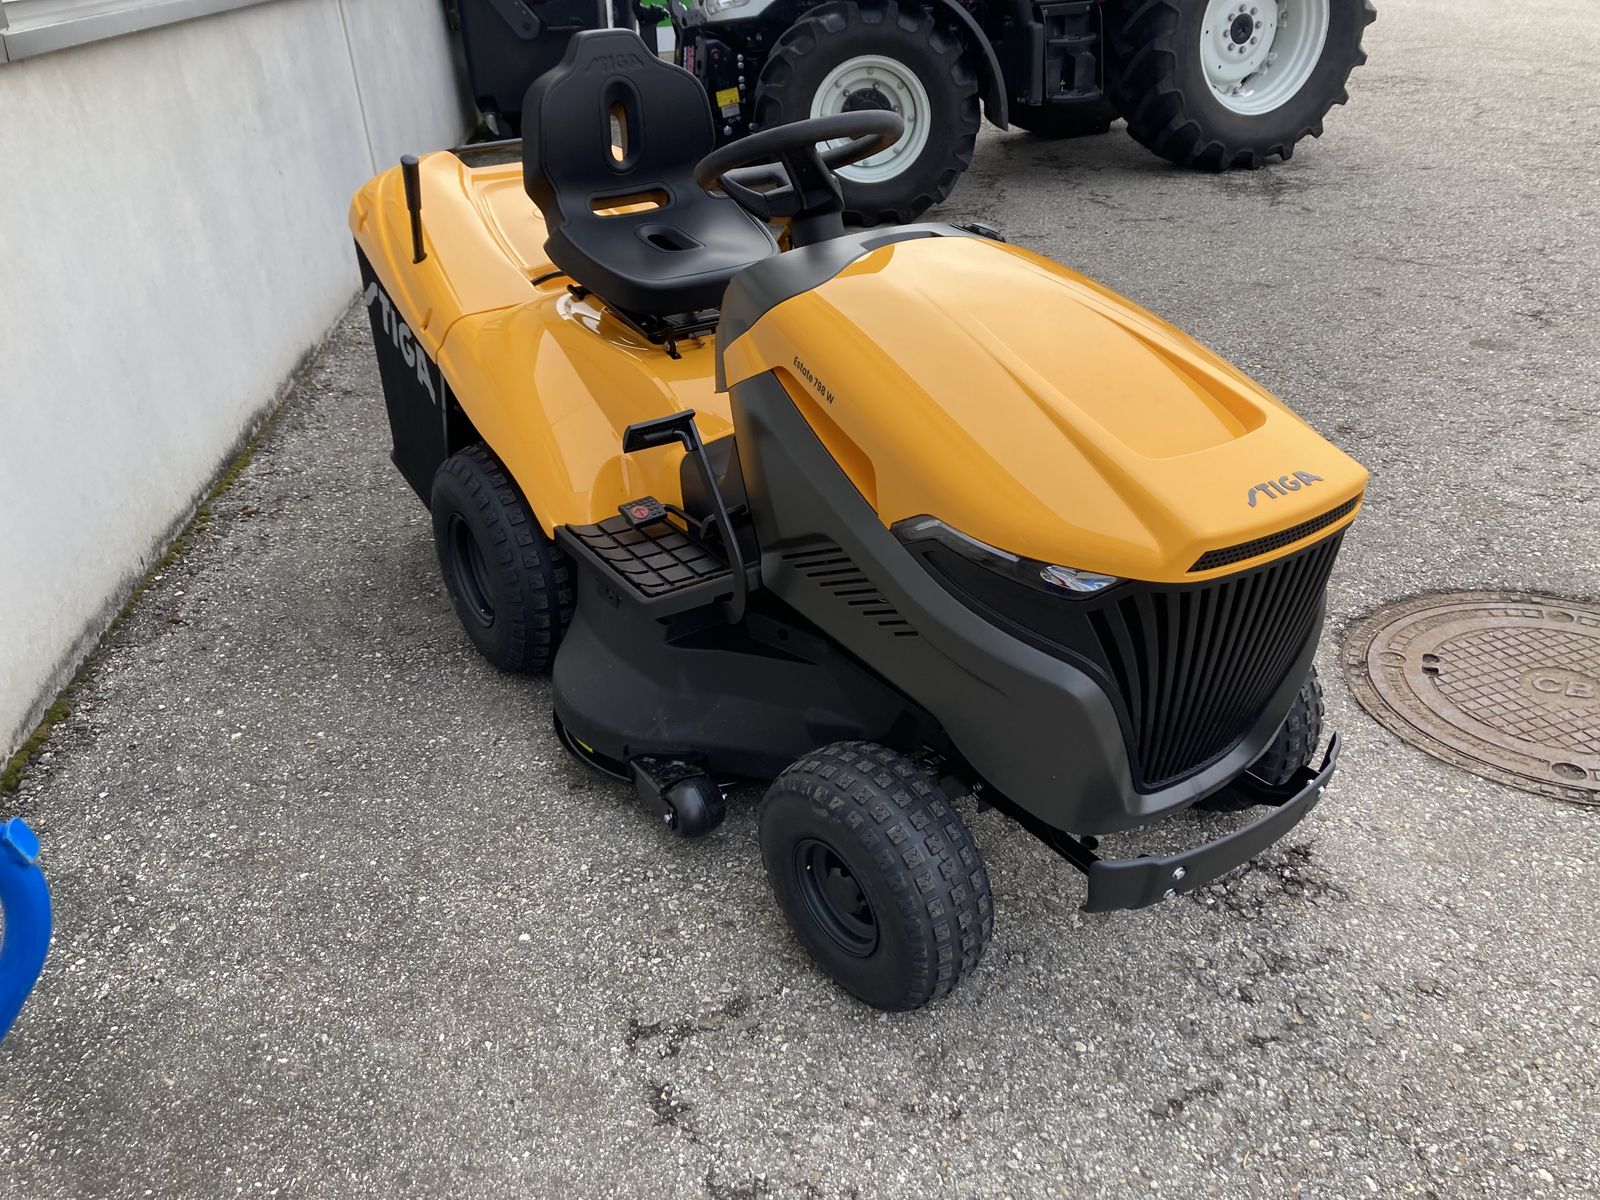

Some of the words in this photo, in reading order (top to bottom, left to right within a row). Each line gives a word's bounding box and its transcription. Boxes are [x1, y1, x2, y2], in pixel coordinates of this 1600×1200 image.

[365, 281, 436, 406] STIGA
[793, 355, 813, 383] Estate
[813, 377, 826, 396] 798
[826, 390, 835, 404] W
[1248, 470, 1324, 507] STIGA
